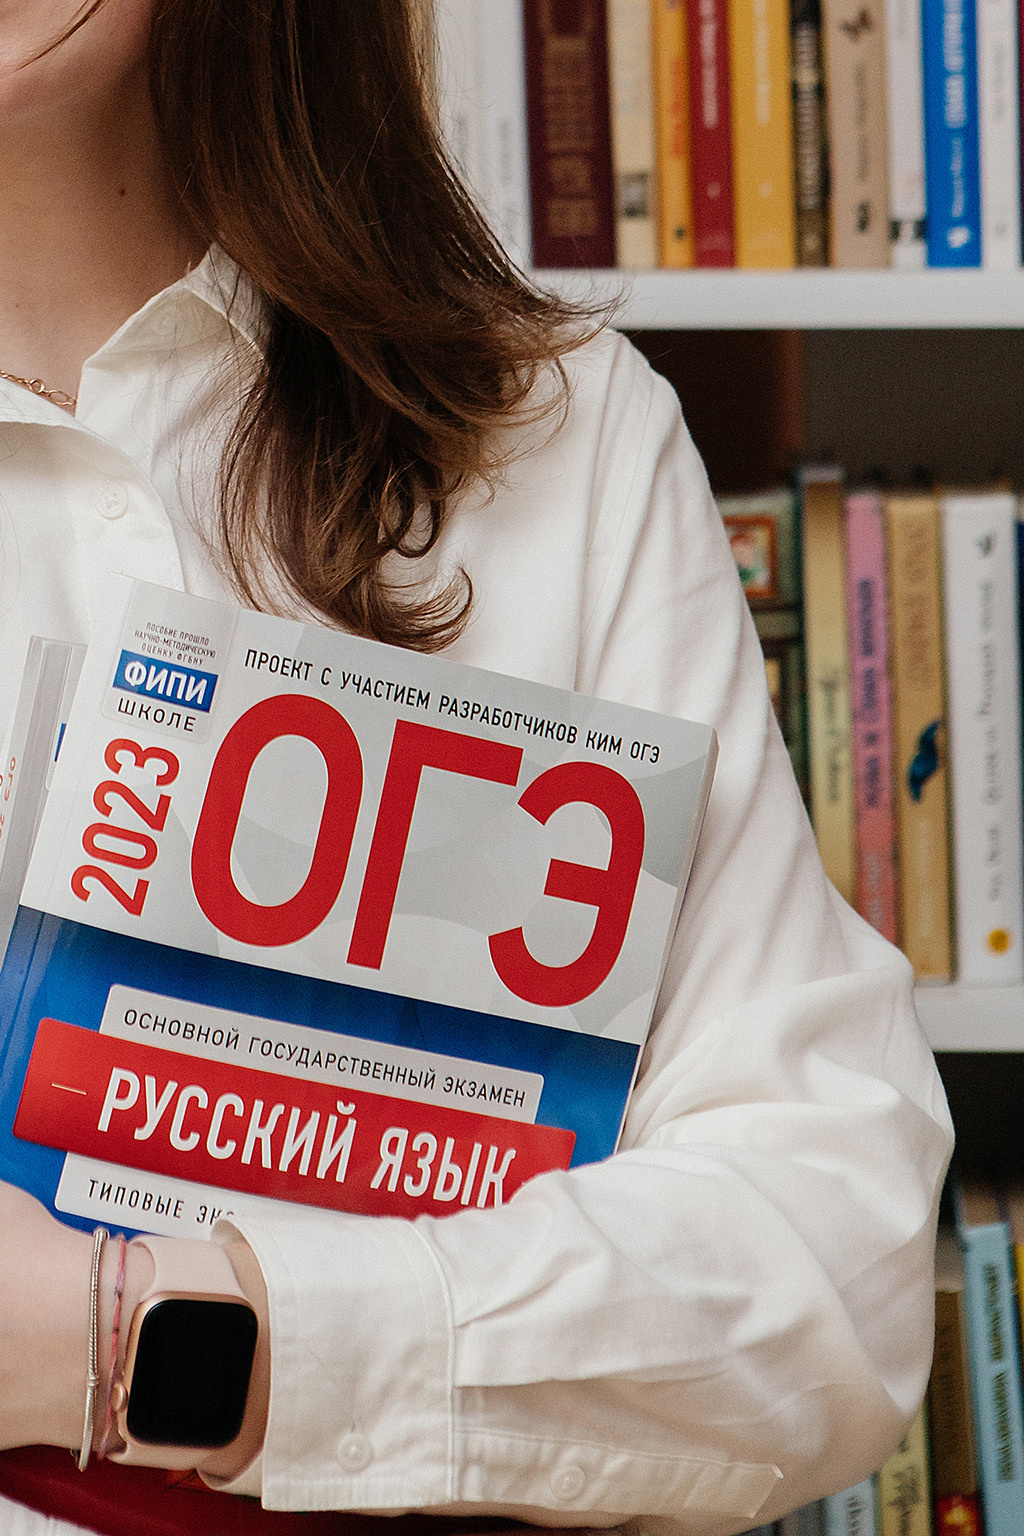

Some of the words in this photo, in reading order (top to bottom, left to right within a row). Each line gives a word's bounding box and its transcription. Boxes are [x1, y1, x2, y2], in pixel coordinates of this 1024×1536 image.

[134, 630, 216, 659] НАУЧНО-МЕТОДИЧЕСКУЮ
[141, 643, 174, 658] ОЦЕНКУ
[176, 653, 204, 666] ФГБНУ
[146, 622, 177, 638] ПОСОБИЕ
[179, 632, 210, 646] ПРОШЛО
[124, 660, 208, 705] ФИПИ
[117, 697, 197, 732] ШКОЛЕ
[244, 648, 313, 682] ПРОЕКТ
[320, 667, 332, 685] С
[340, 671, 431, 710] УЧАСТИЕМ
[438, 694, 578, 744] РАЗРАБОТЧИКОВ
[585, 730, 622, 755] КИМ
[629, 740, 661, 764] ОГЭ
[4, 756, 16, 802] ОГЭ
[70, 737, 181, 917] 2023
[190, 694, 645, 1008] ОГЭ
[123, 1008, 240, 1051] ОСНОВНОЙ
[248, 1037, 436, 1091] ГОСУДАРСТВЕННЫЙ
[442, 1076, 527, 1109] ЭКЗАМЕН
[97, 1066, 358, 1183] РУССКИЙ
[370, 1126, 517, 1209] ЯЗЫК
[88, 1179, 185, 1219] ТИПОВЫЕ
